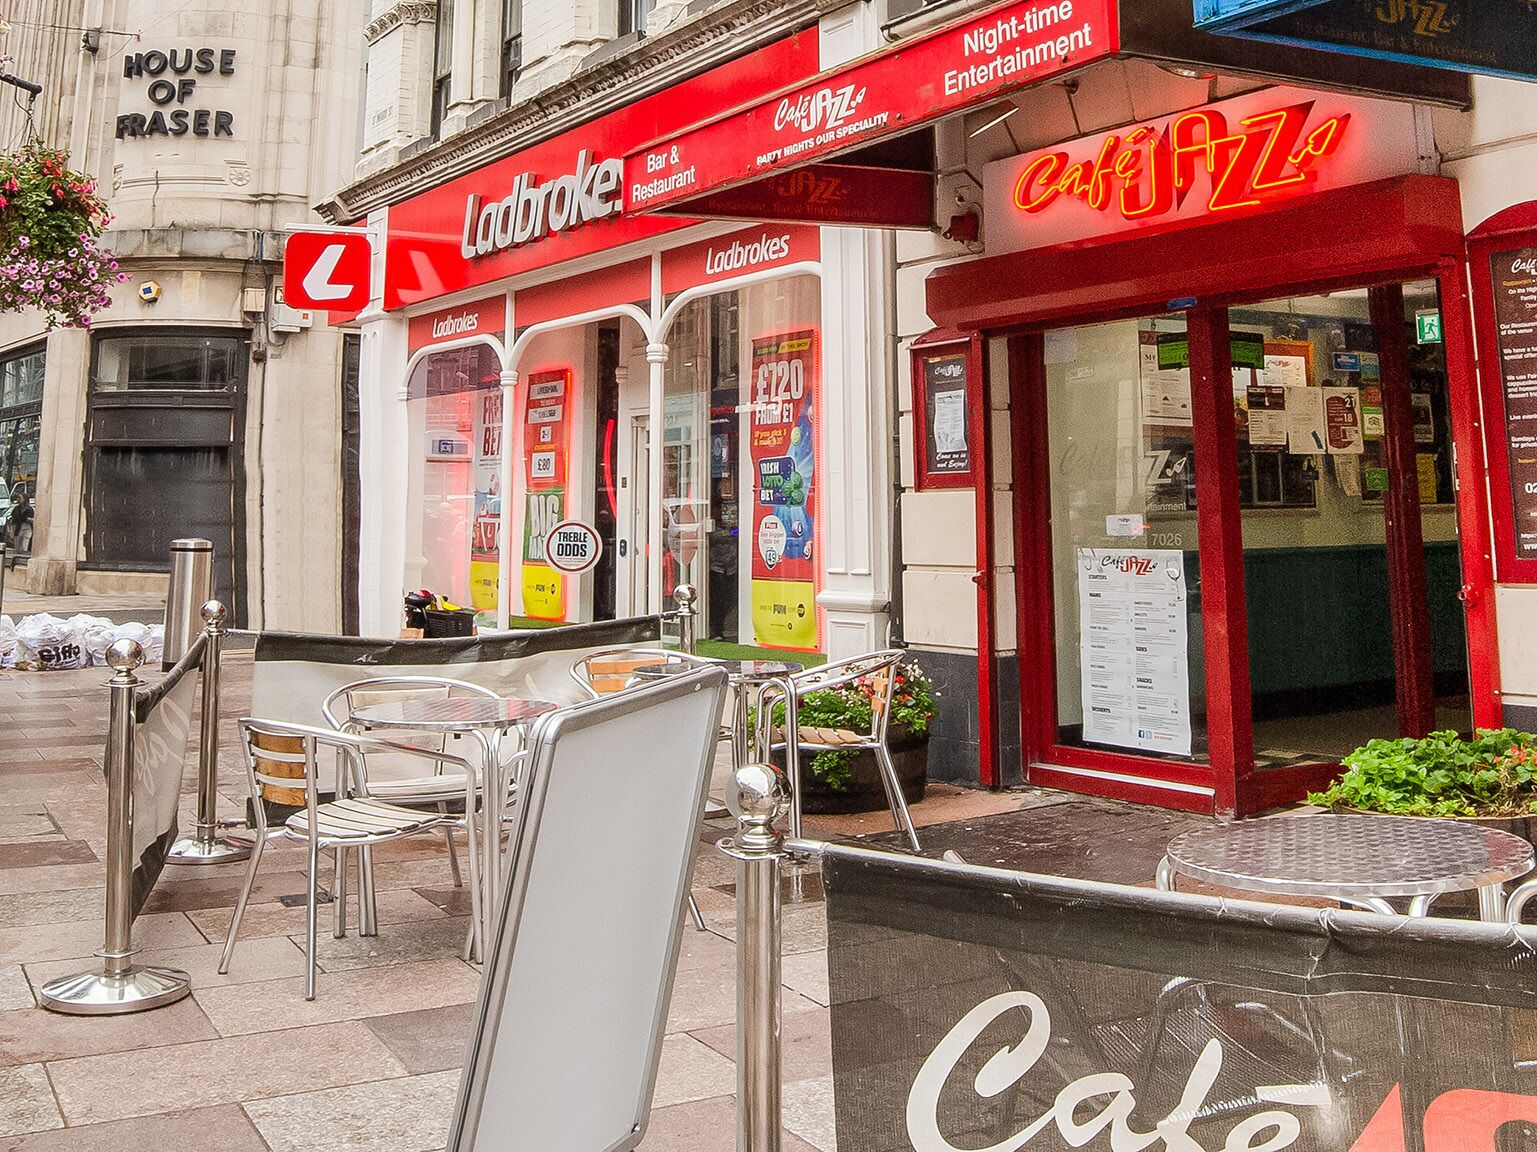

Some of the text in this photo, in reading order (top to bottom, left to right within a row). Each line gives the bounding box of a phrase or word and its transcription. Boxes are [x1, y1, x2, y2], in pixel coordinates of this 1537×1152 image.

[963, 0, 1073, 56] Night-time
[124, 48, 236, 78] HOUSE
[943, 35, 1092, 96] Entertainment
[148, 79, 196, 104] OF
[774, 84, 856, 132] Café JAZZ
[115, 110, 233, 138] FRASER
[757, 112, 889, 165] PARTY NIGHTS OUR SPECIALITY
[647, 146, 680, 173] Bar &
[1014, 100, 1316, 218] Café JAZZ
[632, 167, 695, 202] Restaurant
[705, 232, 790, 276] Ladbrokes
[432, 311, 478, 339] Ladbrokes
[757, 359, 803, 402] £720
[761, 462, 779, 475] IRISH
[761, 489, 773, 501] BET
[557, 543, 588, 557] ODDS
[558, 532, 588, 543] TREBLE
